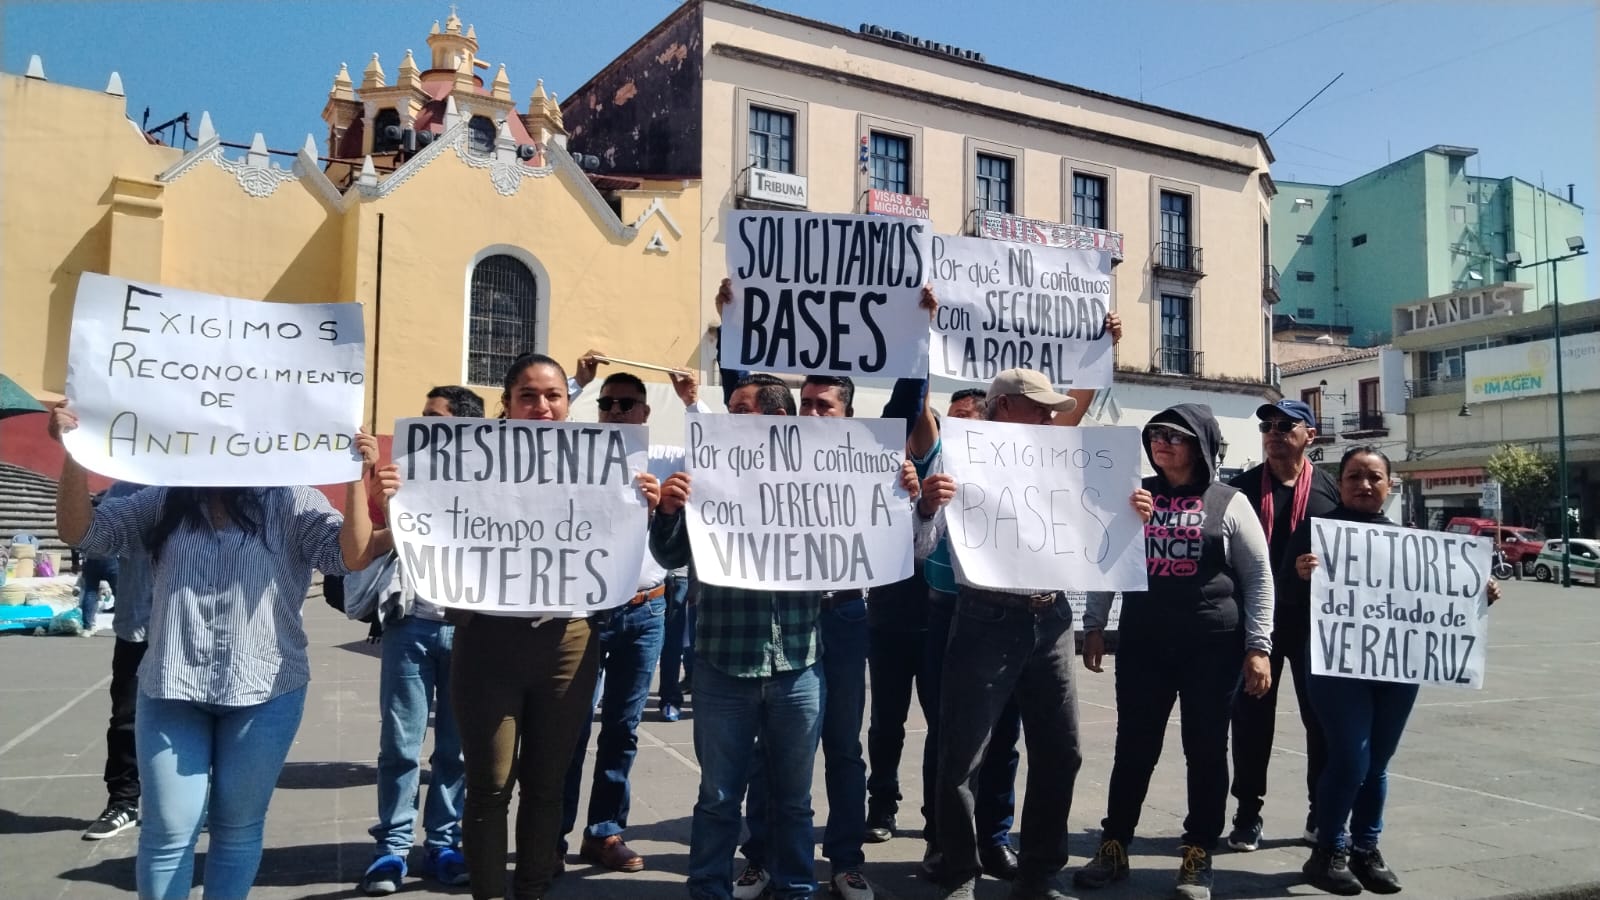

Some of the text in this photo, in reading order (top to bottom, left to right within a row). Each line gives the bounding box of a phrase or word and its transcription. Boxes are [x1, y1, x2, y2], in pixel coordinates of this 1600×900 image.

[755, 172, 804, 197] TRIBUNA
[874, 190, 902, 204] VISAS
[905, 196, 912, 206] &
[874, 201, 928, 218] MIGRACIÓN
[738, 216, 924, 288] SOLICITAMOS
[931, 235, 1110, 295] Por qué NO contamos
[121, 284, 338, 341] EXIGIMOS
[740, 287, 887, 372] BASES
[937, 290, 1107, 342] con SEGURIDAD
[109, 341, 364, 385] RECONOCIMIENTO
[942, 335, 1073, 385] LABORAL
[1484, 376, 1542, 394] IMAGEN
[201, 391, 235, 408] DE
[108, 411, 351, 457] ANTIGÜEDAD
[690, 421, 901, 477] Por qué NO contamos
[965, 430, 1113, 469] EXIGIMOS
[397, 496, 592, 547] es tiempo de
[701, 482, 891, 528] con DERECHO A
[961, 482, 1110, 565] BASES
[1152, 494, 1204, 512] CKO
[709, 532, 874, 583] VIVIENDA
[1145, 538, 1201, 559] INCE
[1315, 524, 1481, 598] VECTORES
[402, 541, 609, 607] MUJERES
[1321, 589, 1466, 628] del estado de
[1317, 619, 1476, 684] VERACRUZ
